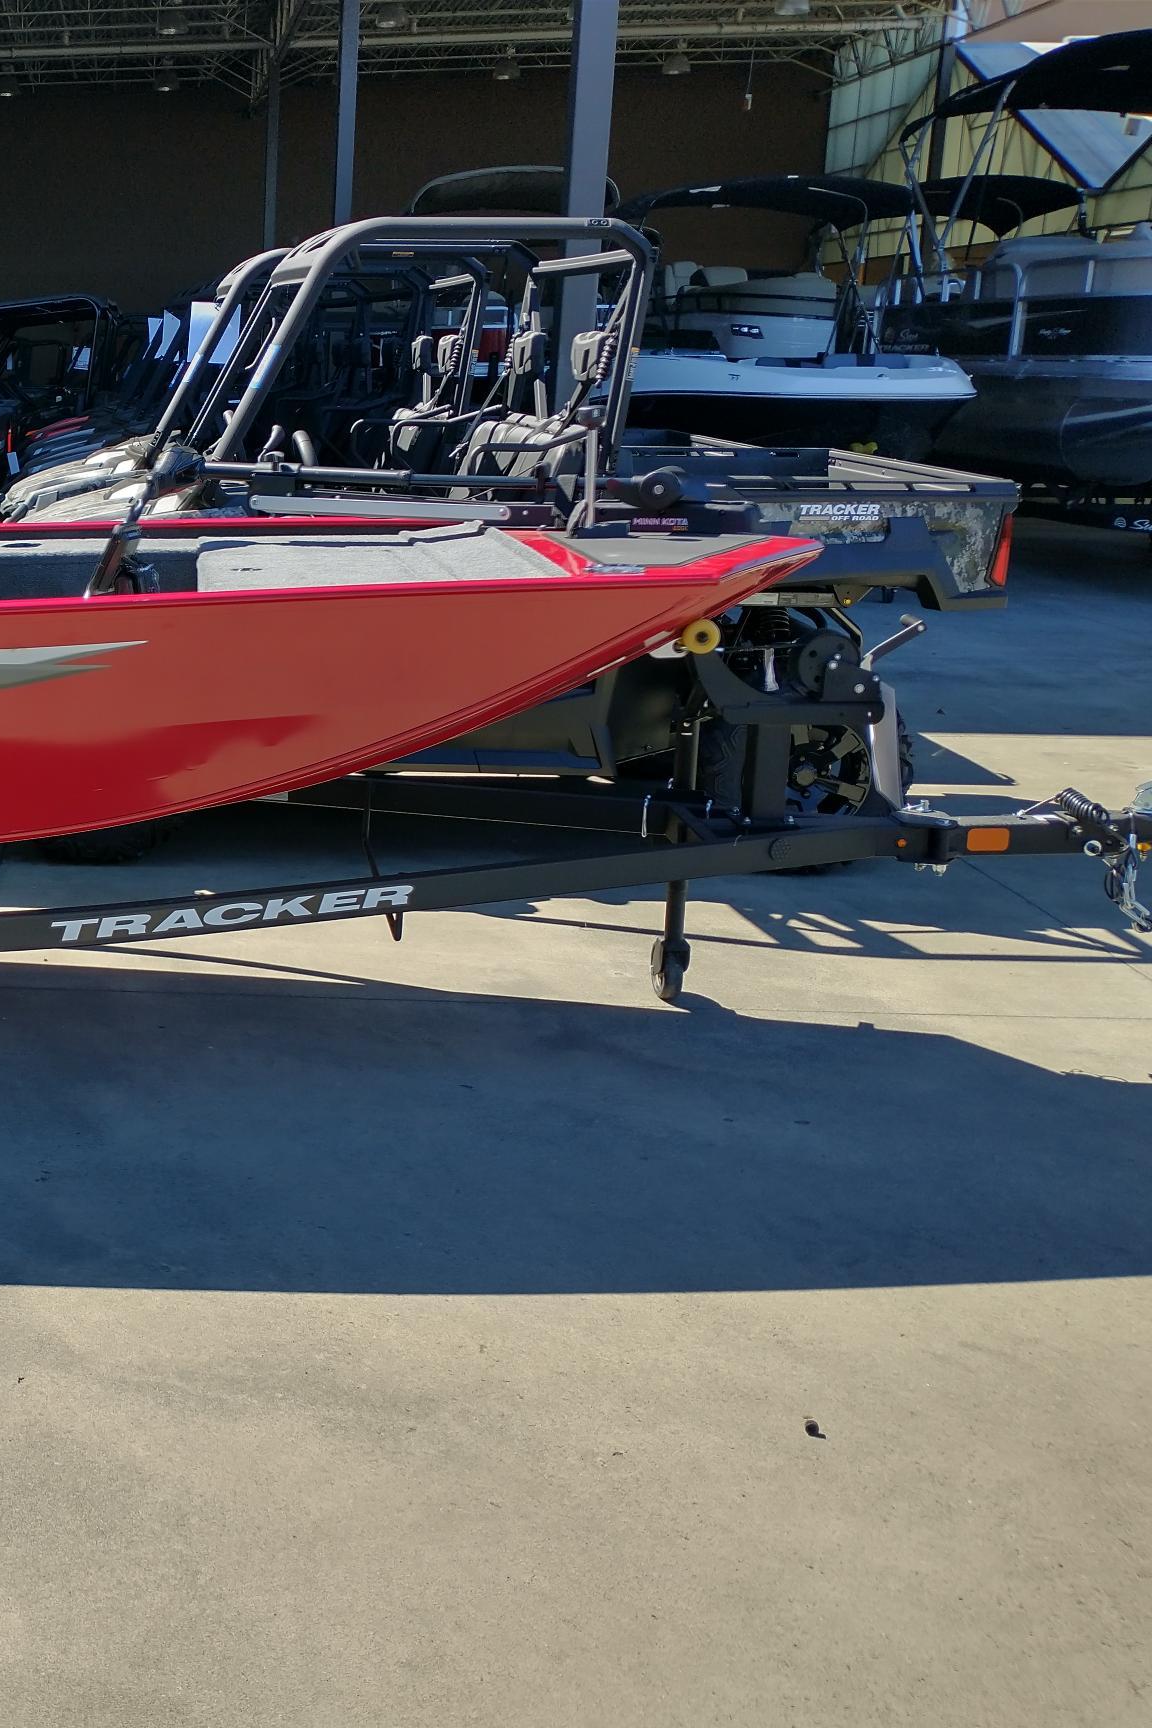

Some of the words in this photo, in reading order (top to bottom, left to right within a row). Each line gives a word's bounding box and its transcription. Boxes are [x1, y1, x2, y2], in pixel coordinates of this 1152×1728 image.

[800, 503, 881, 515] TRACKER
[632, 517, 661, 526] MINN
[661, 517, 689, 526] KOTA
[50, 885, 415, 942] TRACKER
